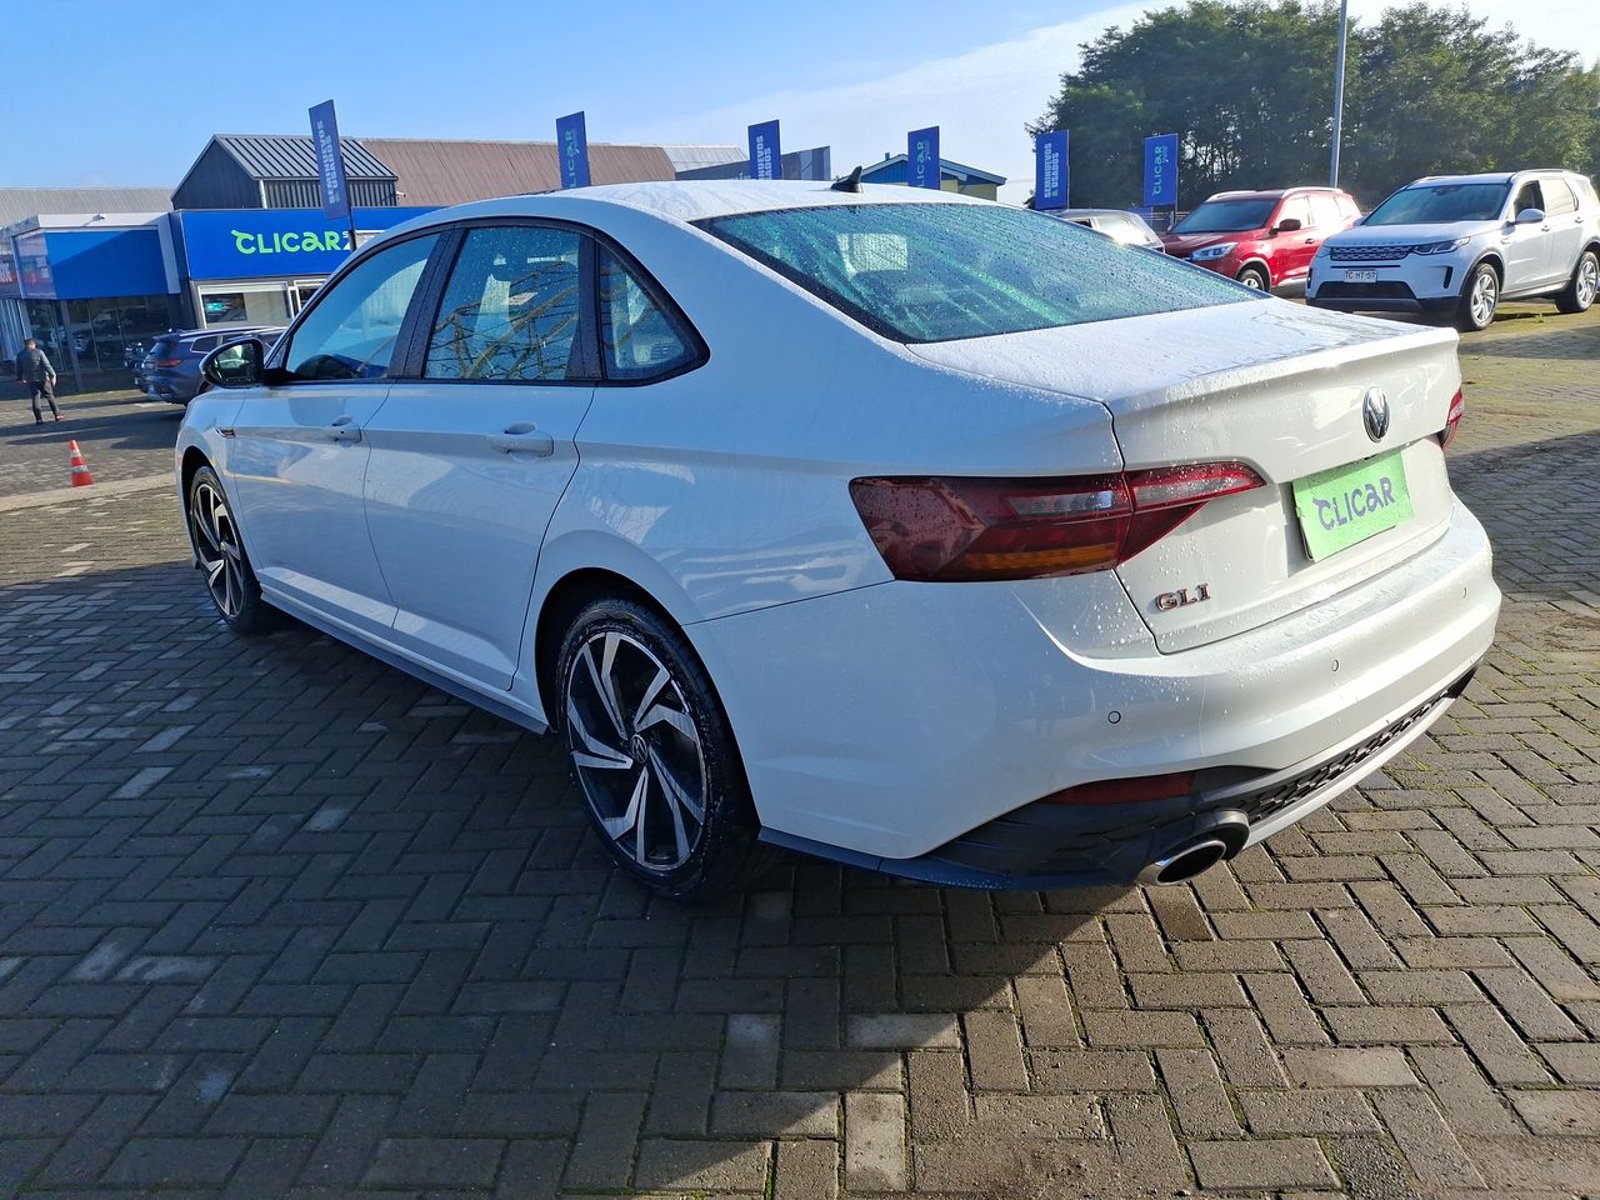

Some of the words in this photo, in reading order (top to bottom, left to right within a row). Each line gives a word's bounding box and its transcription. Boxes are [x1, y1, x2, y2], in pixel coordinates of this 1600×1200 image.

[1044, 143, 1052, 199] SEMINUEVOS
[1051, 152, 1059, 188] USADOS
[1155, 583, 1210, 612] GLI
